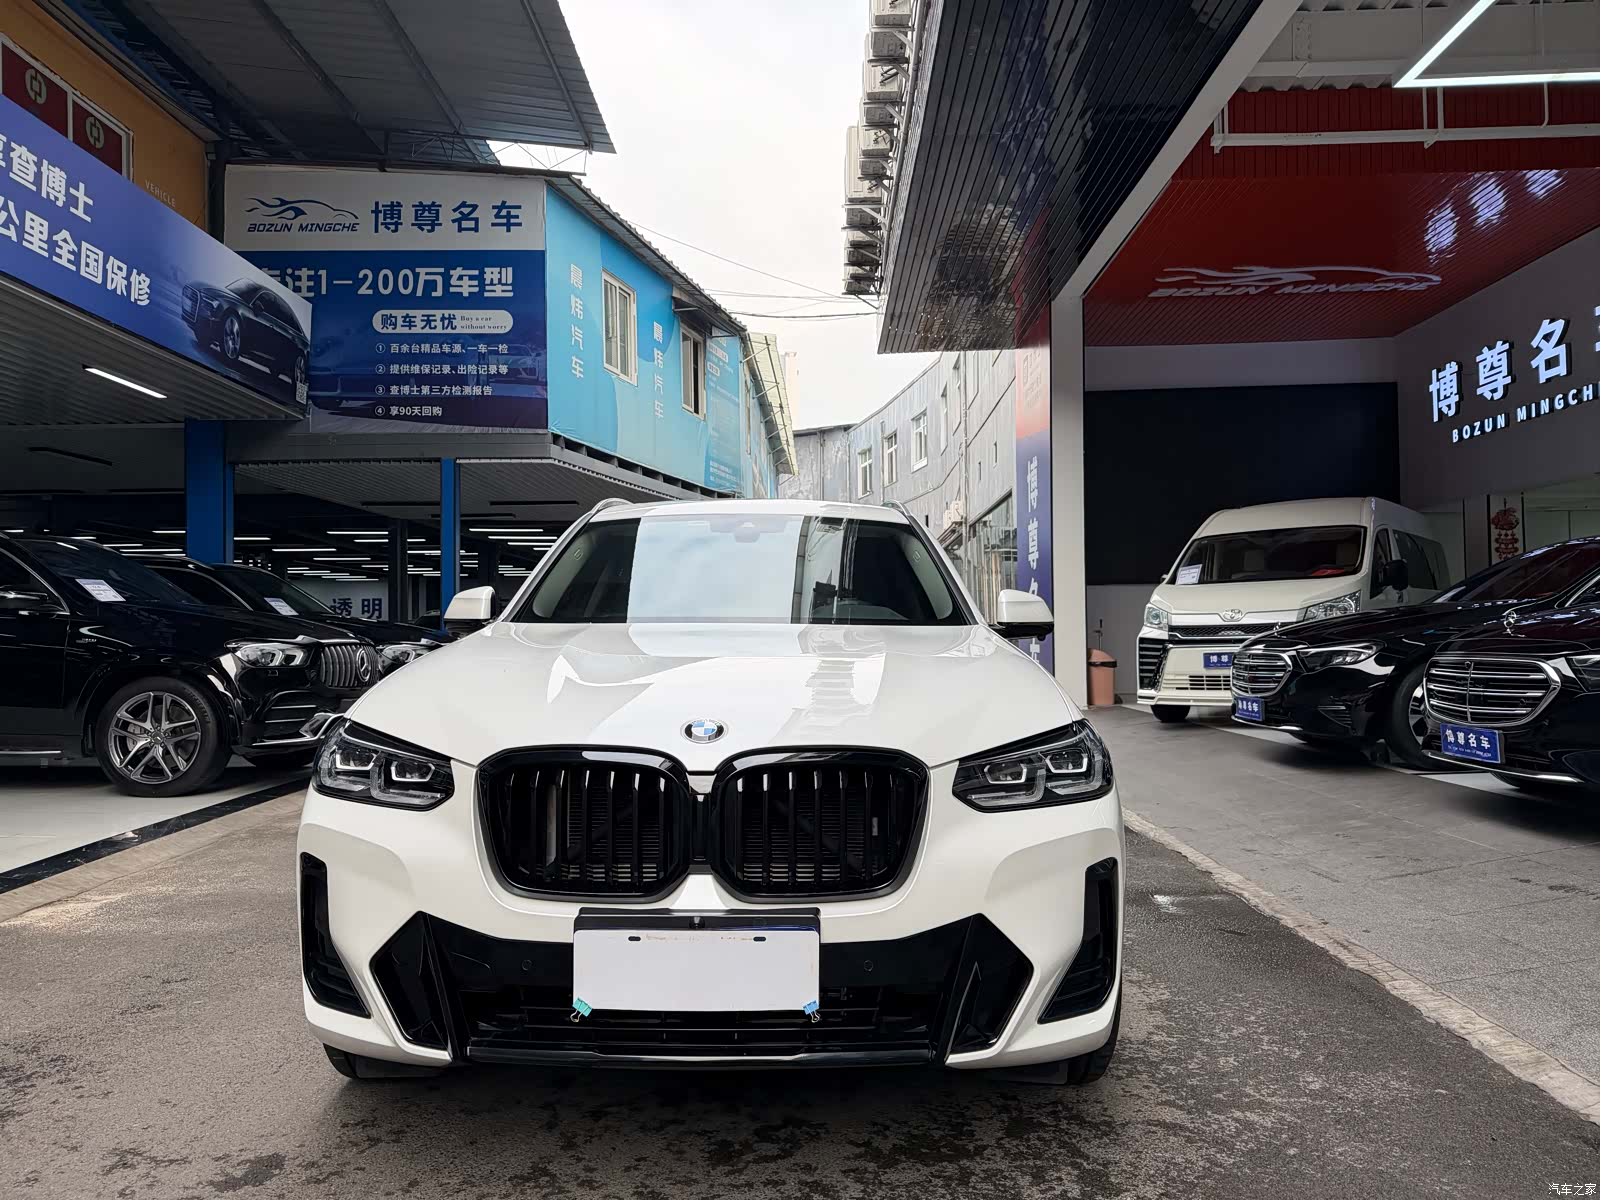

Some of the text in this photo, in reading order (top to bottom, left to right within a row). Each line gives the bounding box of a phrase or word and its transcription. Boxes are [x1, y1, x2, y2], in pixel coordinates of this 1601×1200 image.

[145, 179, 176, 208] VEHICLE
[370, 200, 523, 233] 博尊名车
[247, 222, 360, 232] BOZUN MINGCHE
[380, 313, 457, 331] 购车无忧
[390, 343, 509, 354] 百余台精品车源、一车一检
[389, 364, 509, 375] 提供维保记录、出险记录等
[1429, 304, 1600, 423] 博尊名
[389, 385, 493, 396] 查博士第三方检测报告
[389, 406, 443, 417] 享90天回购
[1452, 381, 1600, 443] BOZUN MINGCH
